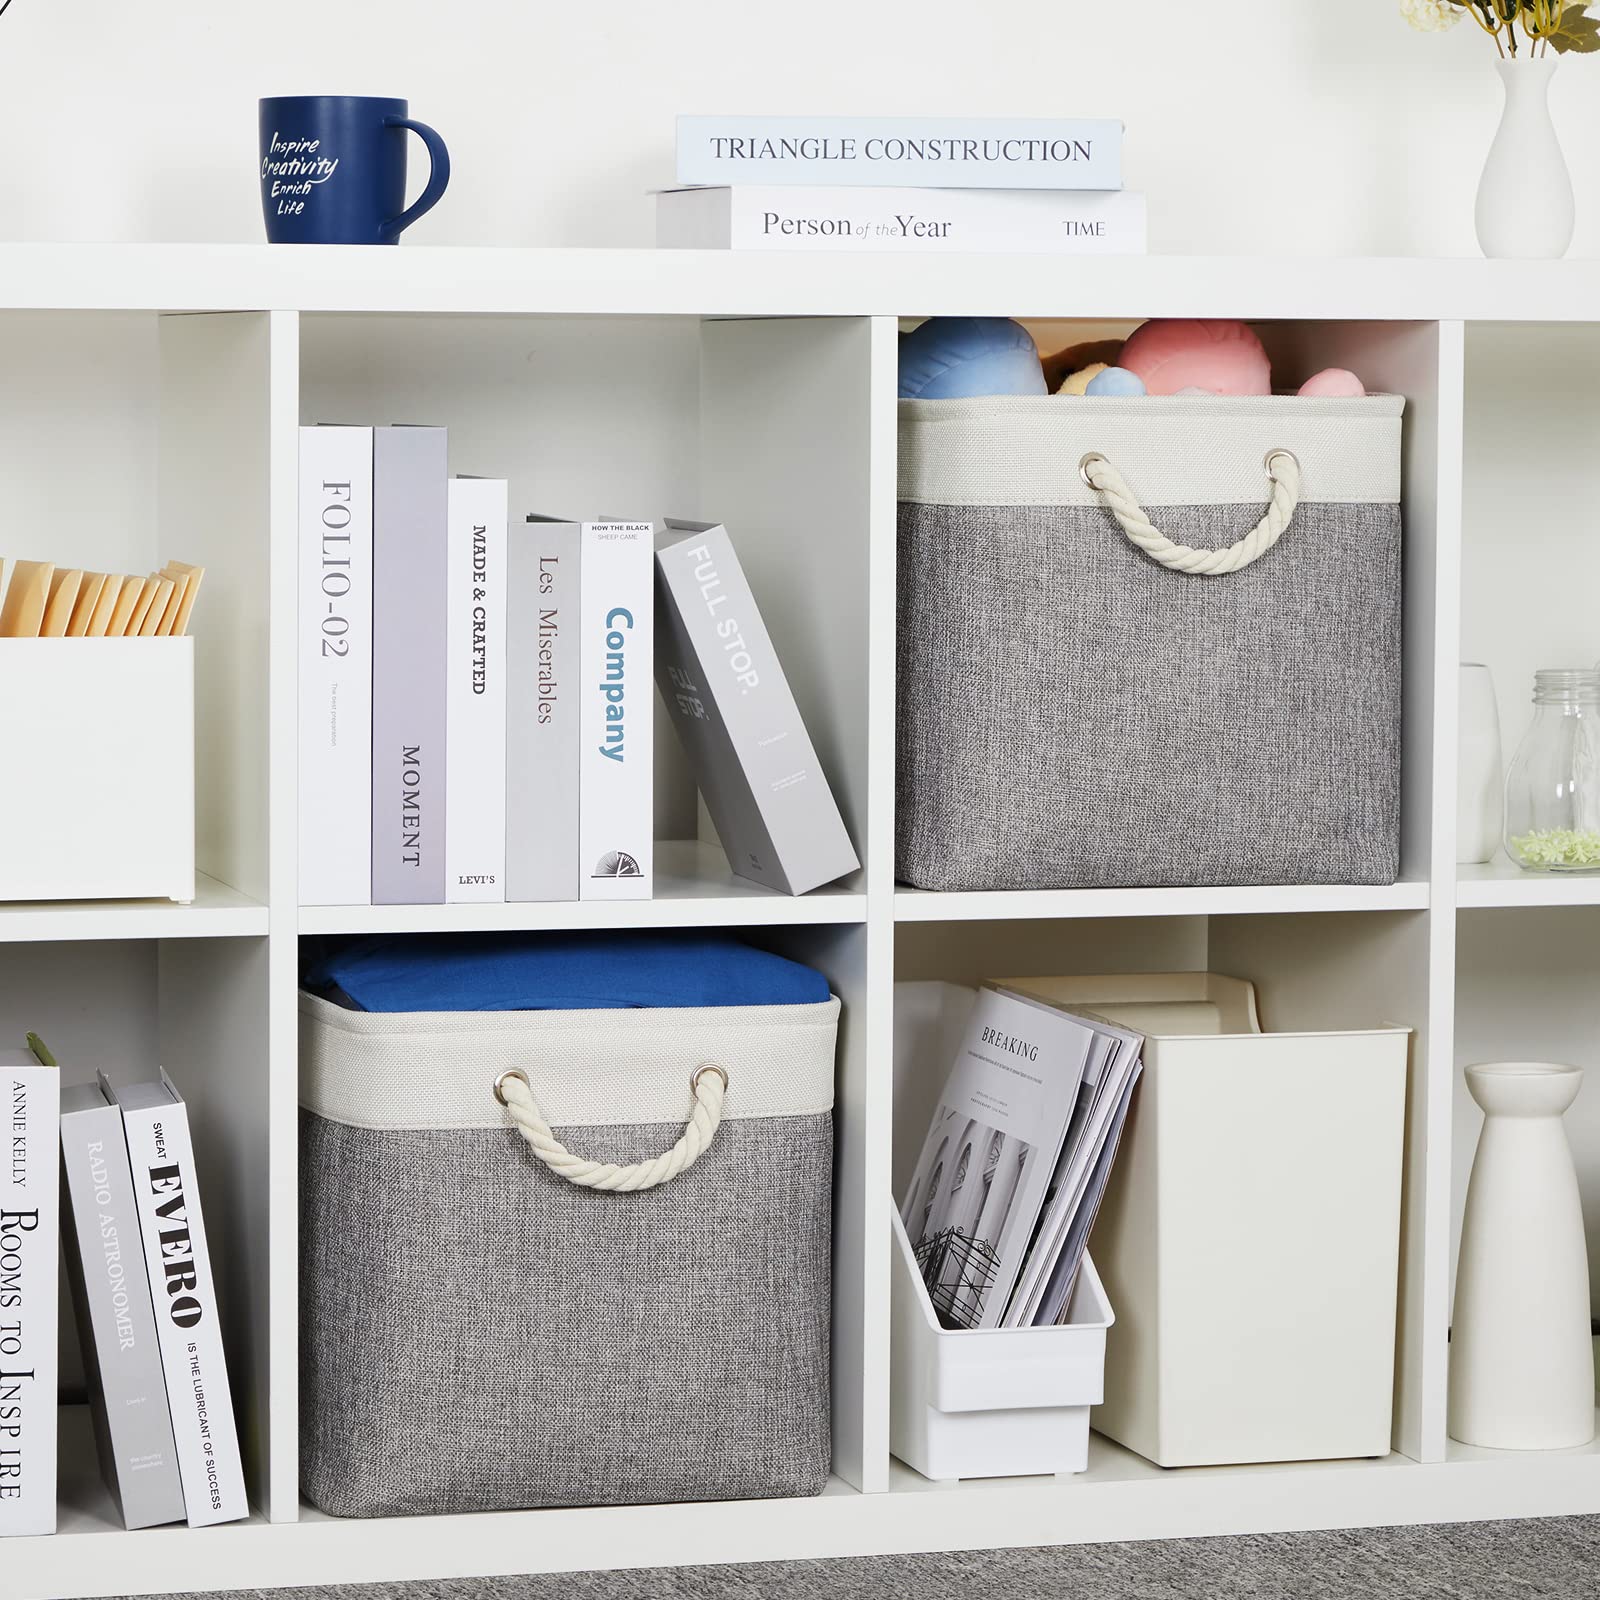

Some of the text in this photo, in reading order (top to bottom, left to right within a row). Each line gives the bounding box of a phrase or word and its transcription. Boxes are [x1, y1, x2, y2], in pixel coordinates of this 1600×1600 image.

[269, 131, 321, 159] Inspire
[710, 138, 1090, 161] TRIANGLE CONSTRUCTION
[261, 155, 339, 184] Creativity
[271, 179, 313, 198] Enrich
[277, 199, 305, 215] Life
[762, 211, 952, 240] Person of the Year
[1062, 220, 1106, 237] TIME
[321, 479, 352, 658] FOLIO-02
[472, 525, 487, 695] MADE & CRAFTED
[686, 544, 760, 696] FULL STOP.
[538, 556, 559, 725] Les Miserables
[598, 606, 634, 763] Company
[402, 745, 421, 868] MOMENT
[458, 875, 496, 885] LEVI'S
[981, 1026, 1039, 1062] BREAKING
[13, 1080, 27, 1188] ANNIE KELLY
[152, 1122, 167, 1160] SWEAT
[87, 1140, 136, 1352] RADIO ASTRONOMER
[147, 1160, 203, 1329] EVERO
[0, 1320, 22, 1355] TO
[187, 1342, 222, 1511] IS THE LUBRICANT OF SUCCESS
